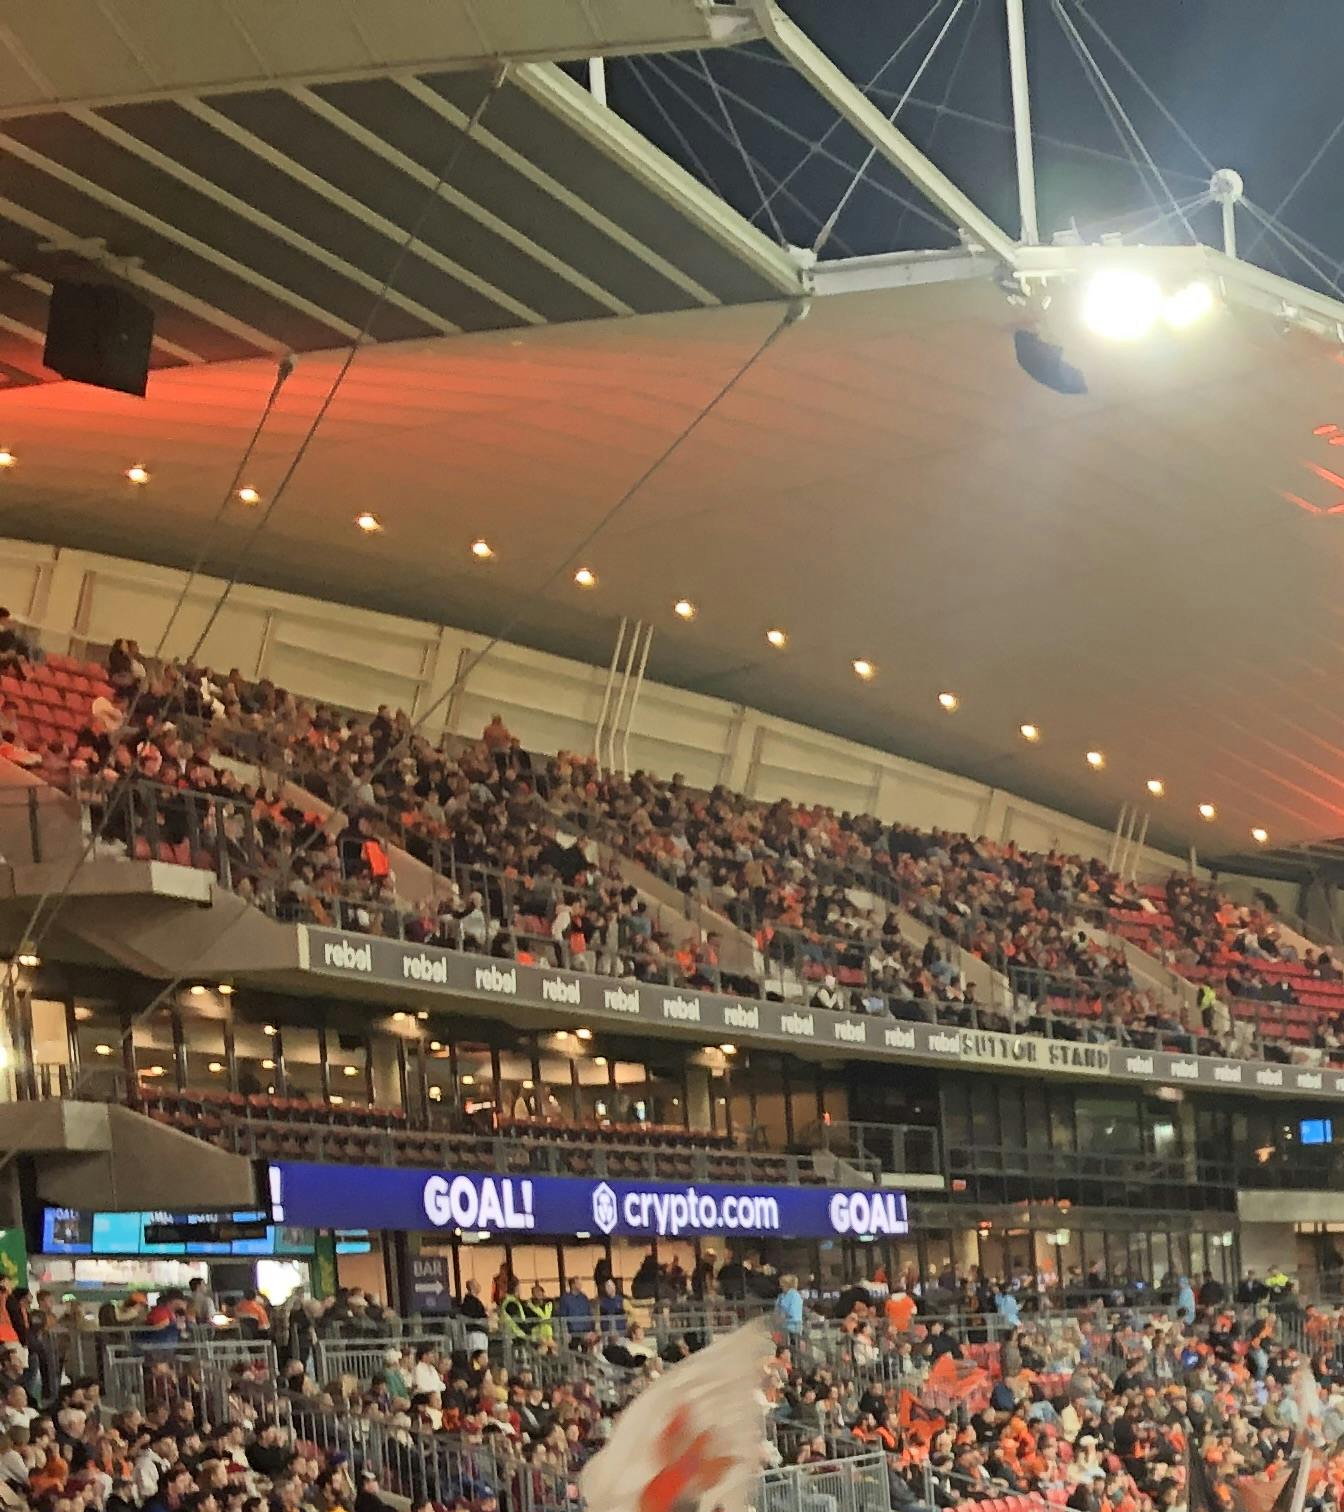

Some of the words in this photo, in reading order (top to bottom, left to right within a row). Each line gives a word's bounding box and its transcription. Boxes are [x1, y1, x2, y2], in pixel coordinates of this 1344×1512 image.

[325, 940, 371, 971] rebel
[403, 954, 447, 983] rebel
[476, 966, 516, 993] rebel
[424, 1175, 535, 1229] GOAL!
[624, 1187, 779, 1236] crypto.com
[830, 1191, 909, 1234] GOAL!
[414, 1259, 443, 1279] BAR
